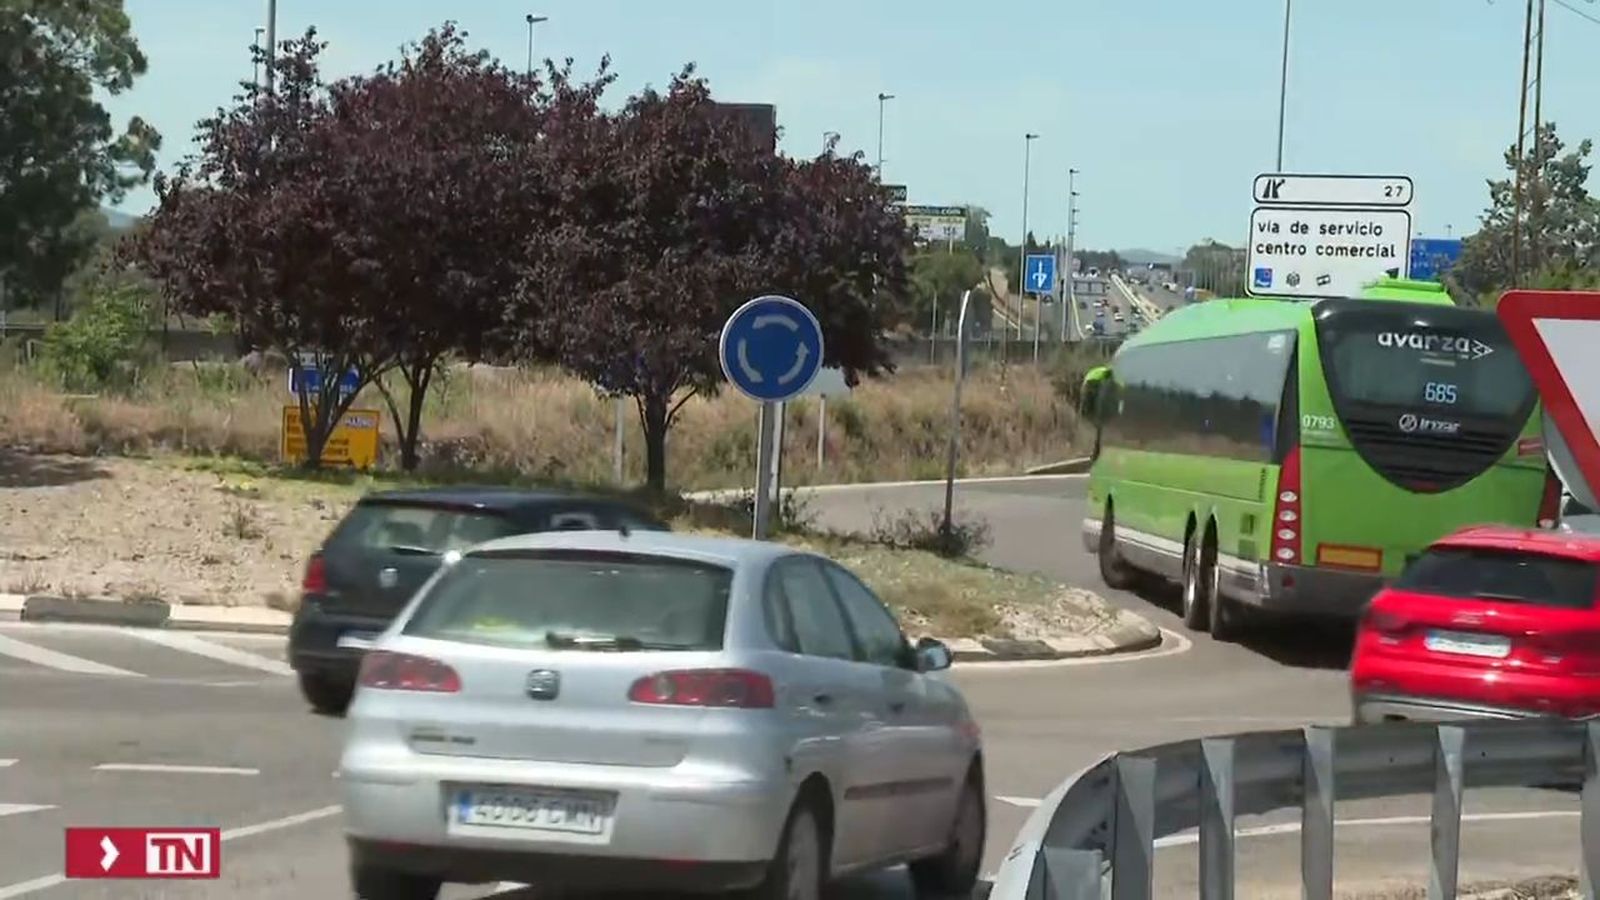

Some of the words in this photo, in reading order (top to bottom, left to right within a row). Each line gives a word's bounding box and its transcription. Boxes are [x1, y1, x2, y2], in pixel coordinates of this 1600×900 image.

[1384, 185, 1404, 198] 27
[1290, 220, 1309, 235] de
[1319, 221, 1383, 237] servicio
[1256, 241, 1307, 256] centro
[1316, 243, 1396, 258] comercial
[1424, 382, 1457, 404] 685
[1303, 415, 1334, 430] 0793
